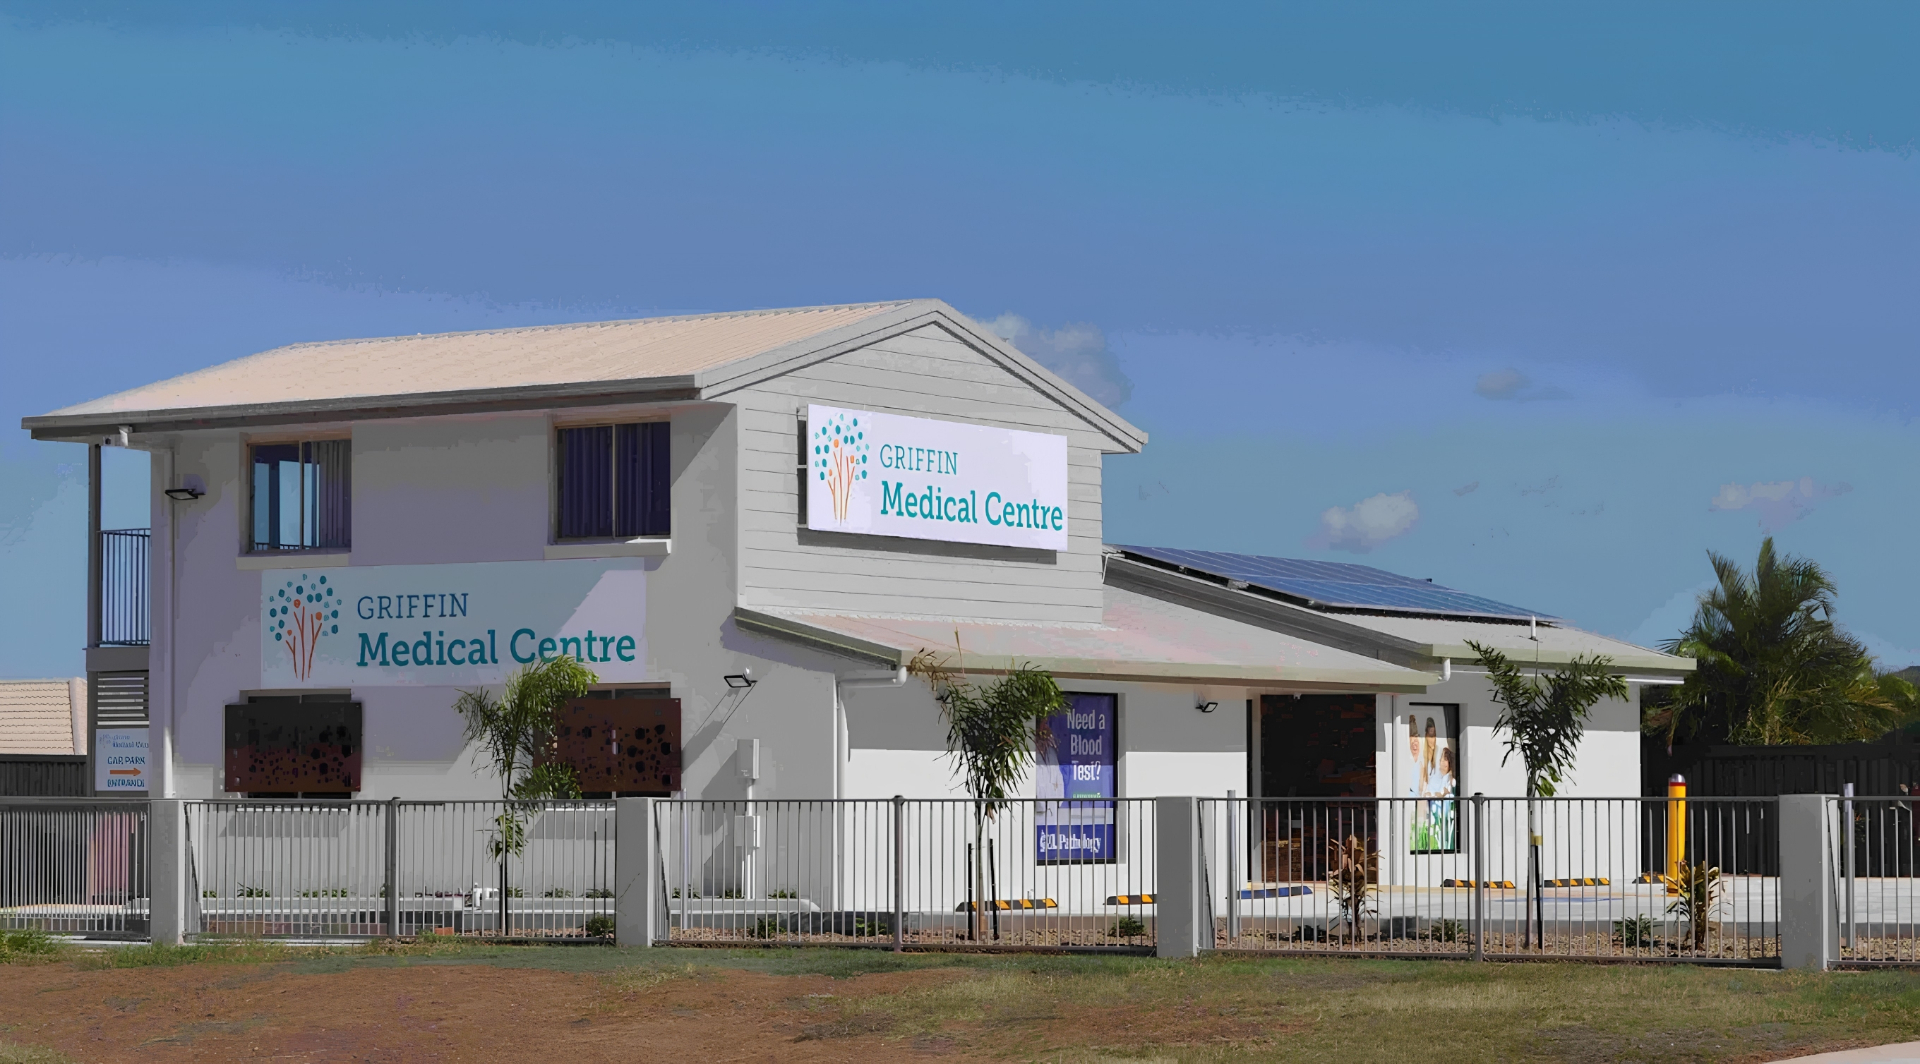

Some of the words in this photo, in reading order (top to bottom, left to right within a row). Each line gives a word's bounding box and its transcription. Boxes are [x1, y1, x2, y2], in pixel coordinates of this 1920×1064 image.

[880, 444, 958, 475] GRIFFIN
[880, 481, 978, 524] Medical
[985, 492, 1063, 531] Centre
[357, 593, 469, 620] GRIFFIN
[356, 629, 498, 667] Medical
[510, 628, 636, 664] Centre
[1067, 708, 1096, 730] Need
[1098, 713, 1106, 730] a
[1070, 734, 1102, 755] Blood
[1071, 760, 1101, 781] Test?
